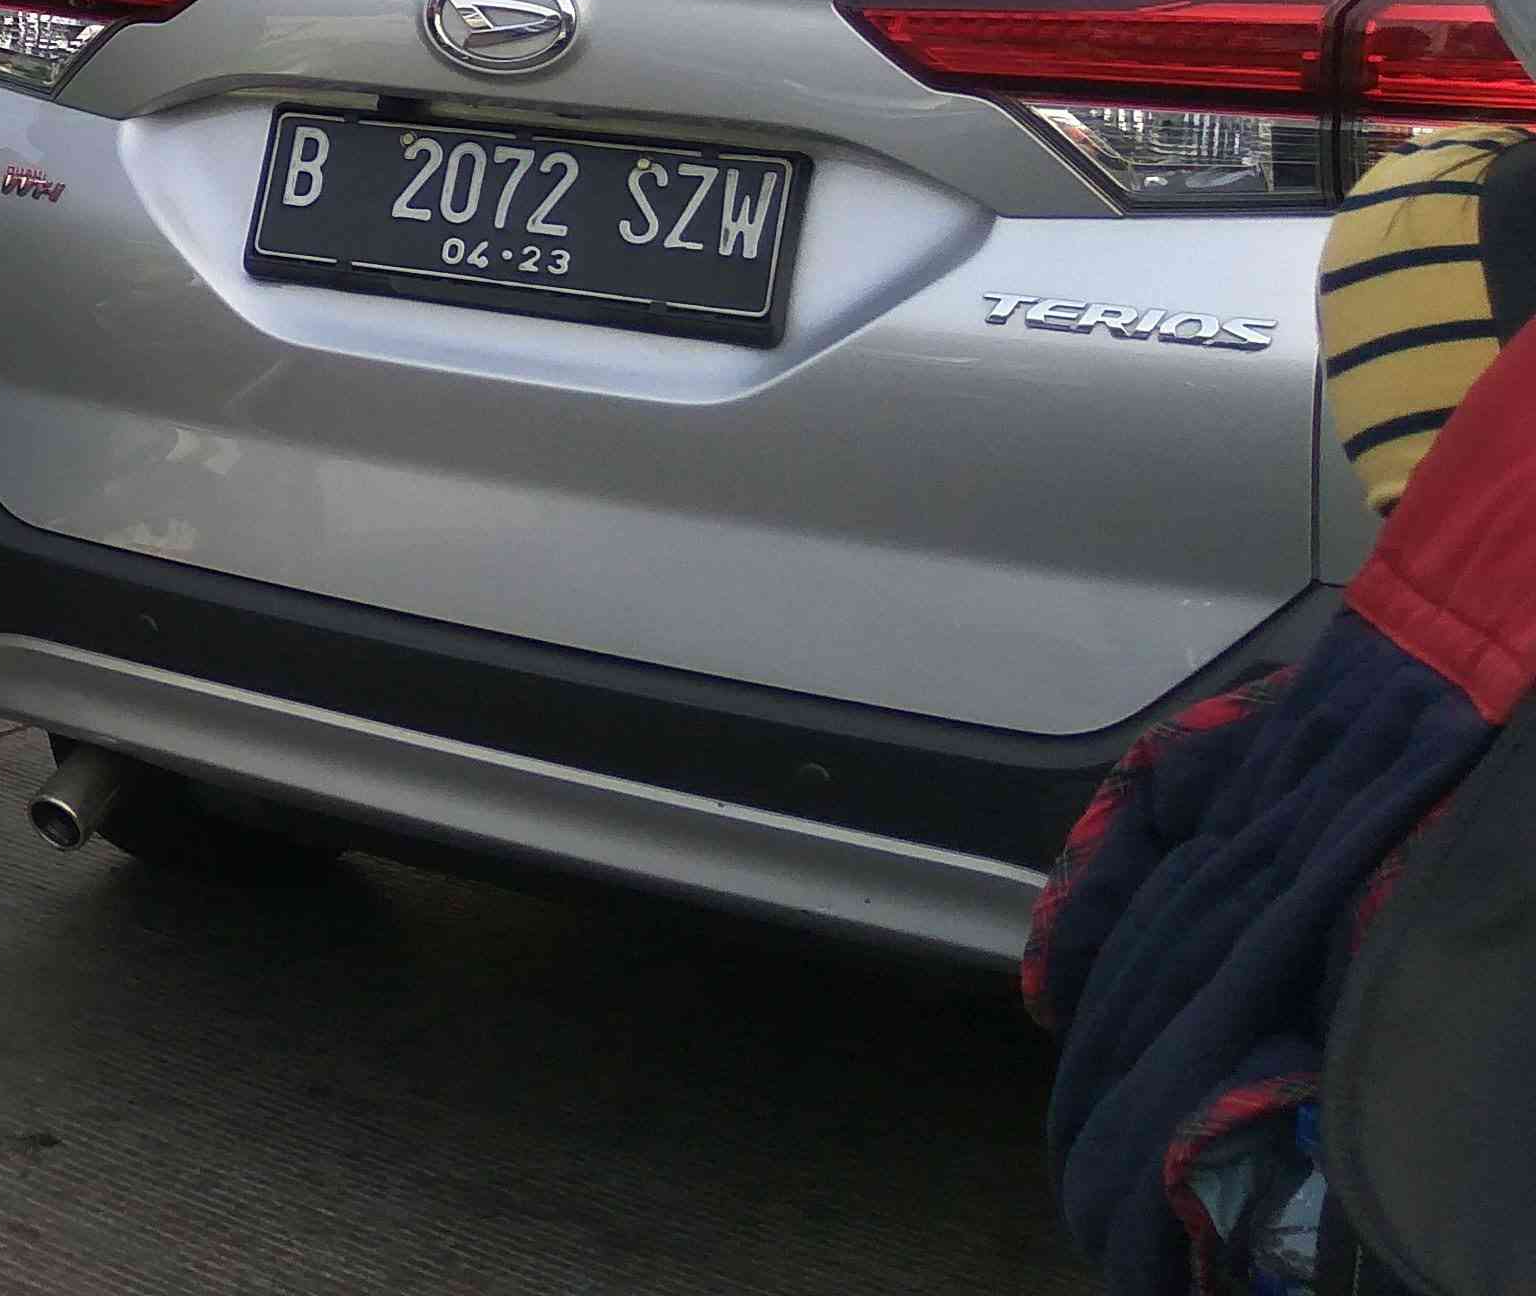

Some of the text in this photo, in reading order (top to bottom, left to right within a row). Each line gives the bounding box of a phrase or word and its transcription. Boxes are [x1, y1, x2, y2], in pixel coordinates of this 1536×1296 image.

[281, 125, 777, 259] B 2072 SZW
[982, 293, 1277, 351] TERIOS
